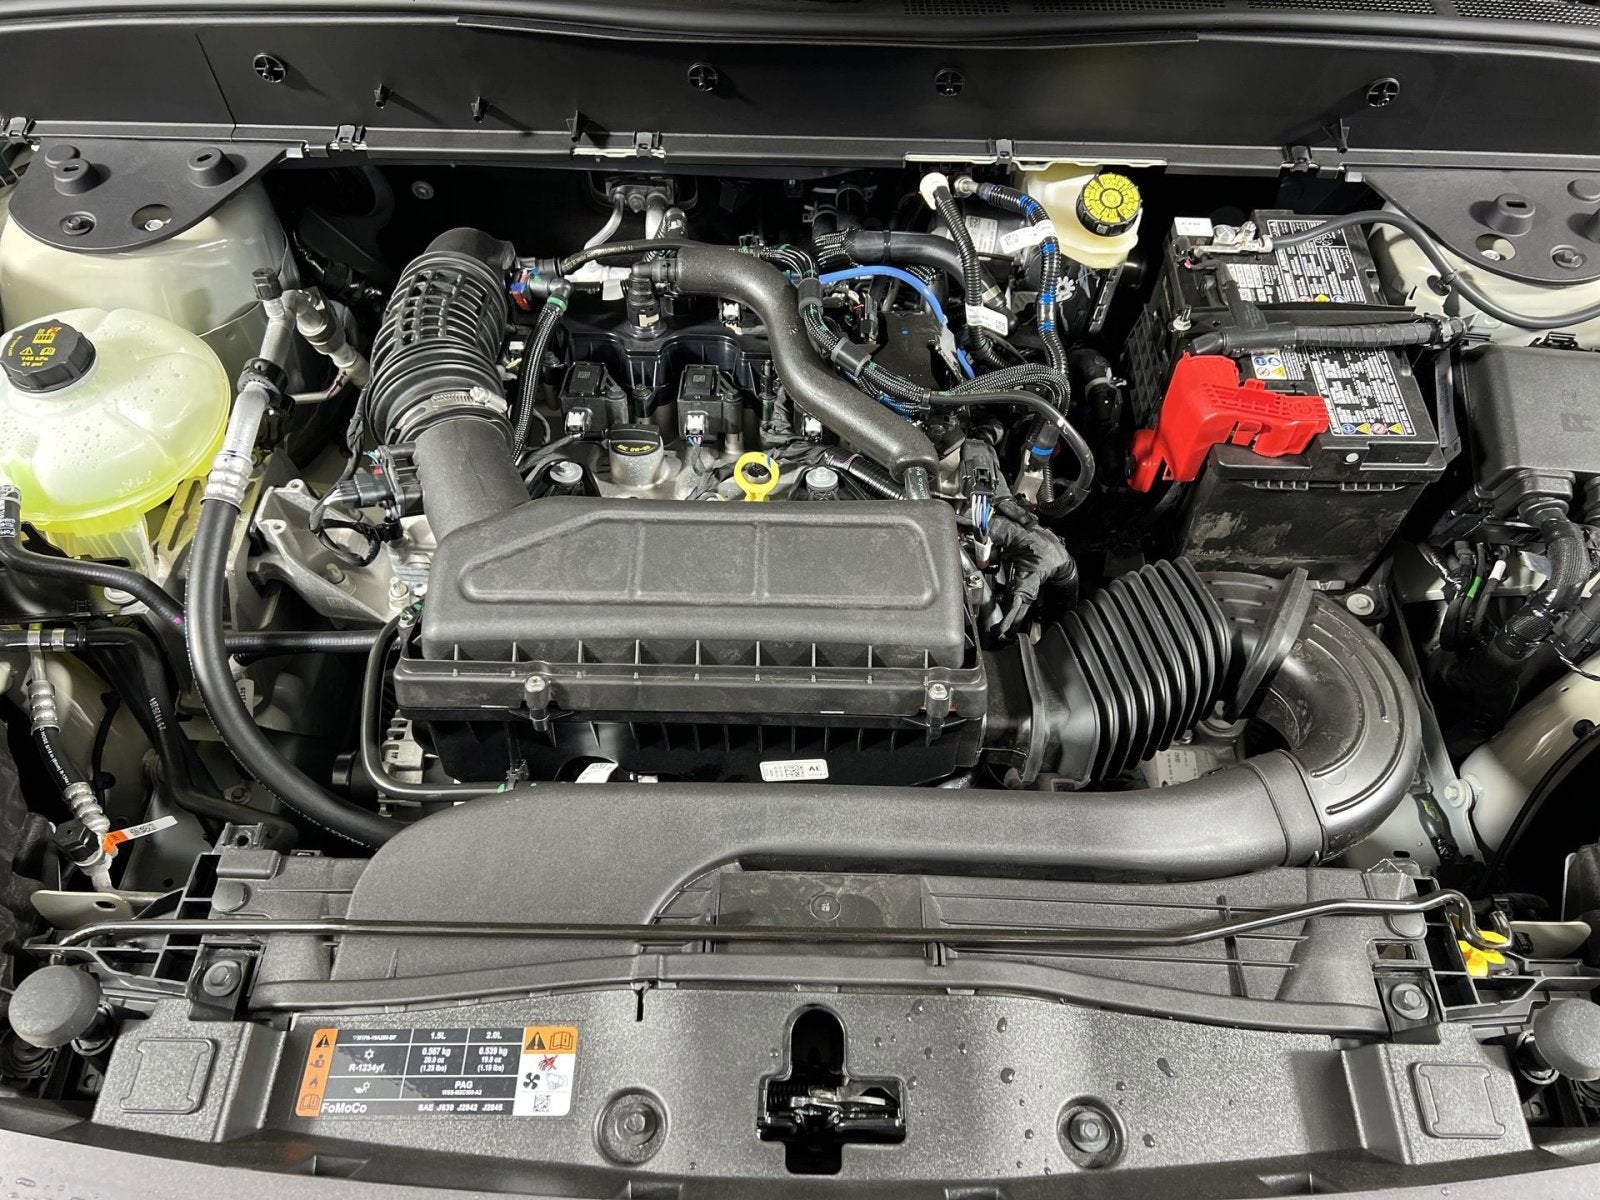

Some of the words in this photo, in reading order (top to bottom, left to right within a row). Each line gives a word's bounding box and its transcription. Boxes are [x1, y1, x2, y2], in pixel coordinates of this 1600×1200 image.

[430, 1031, 446, 1040] 1.5L
[486, 1031, 502, 1040] 2.0L
[441, 1047, 451, 1057] kg
[498, 1047, 508, 1057] kg
[348, 1063, 385, 1073] R-1234yf
[454, 1081, 473, 1089] PAG
[320, 1103, 367, 1113] FoMoCo
[417, 1104, 434, 1112] SAE
